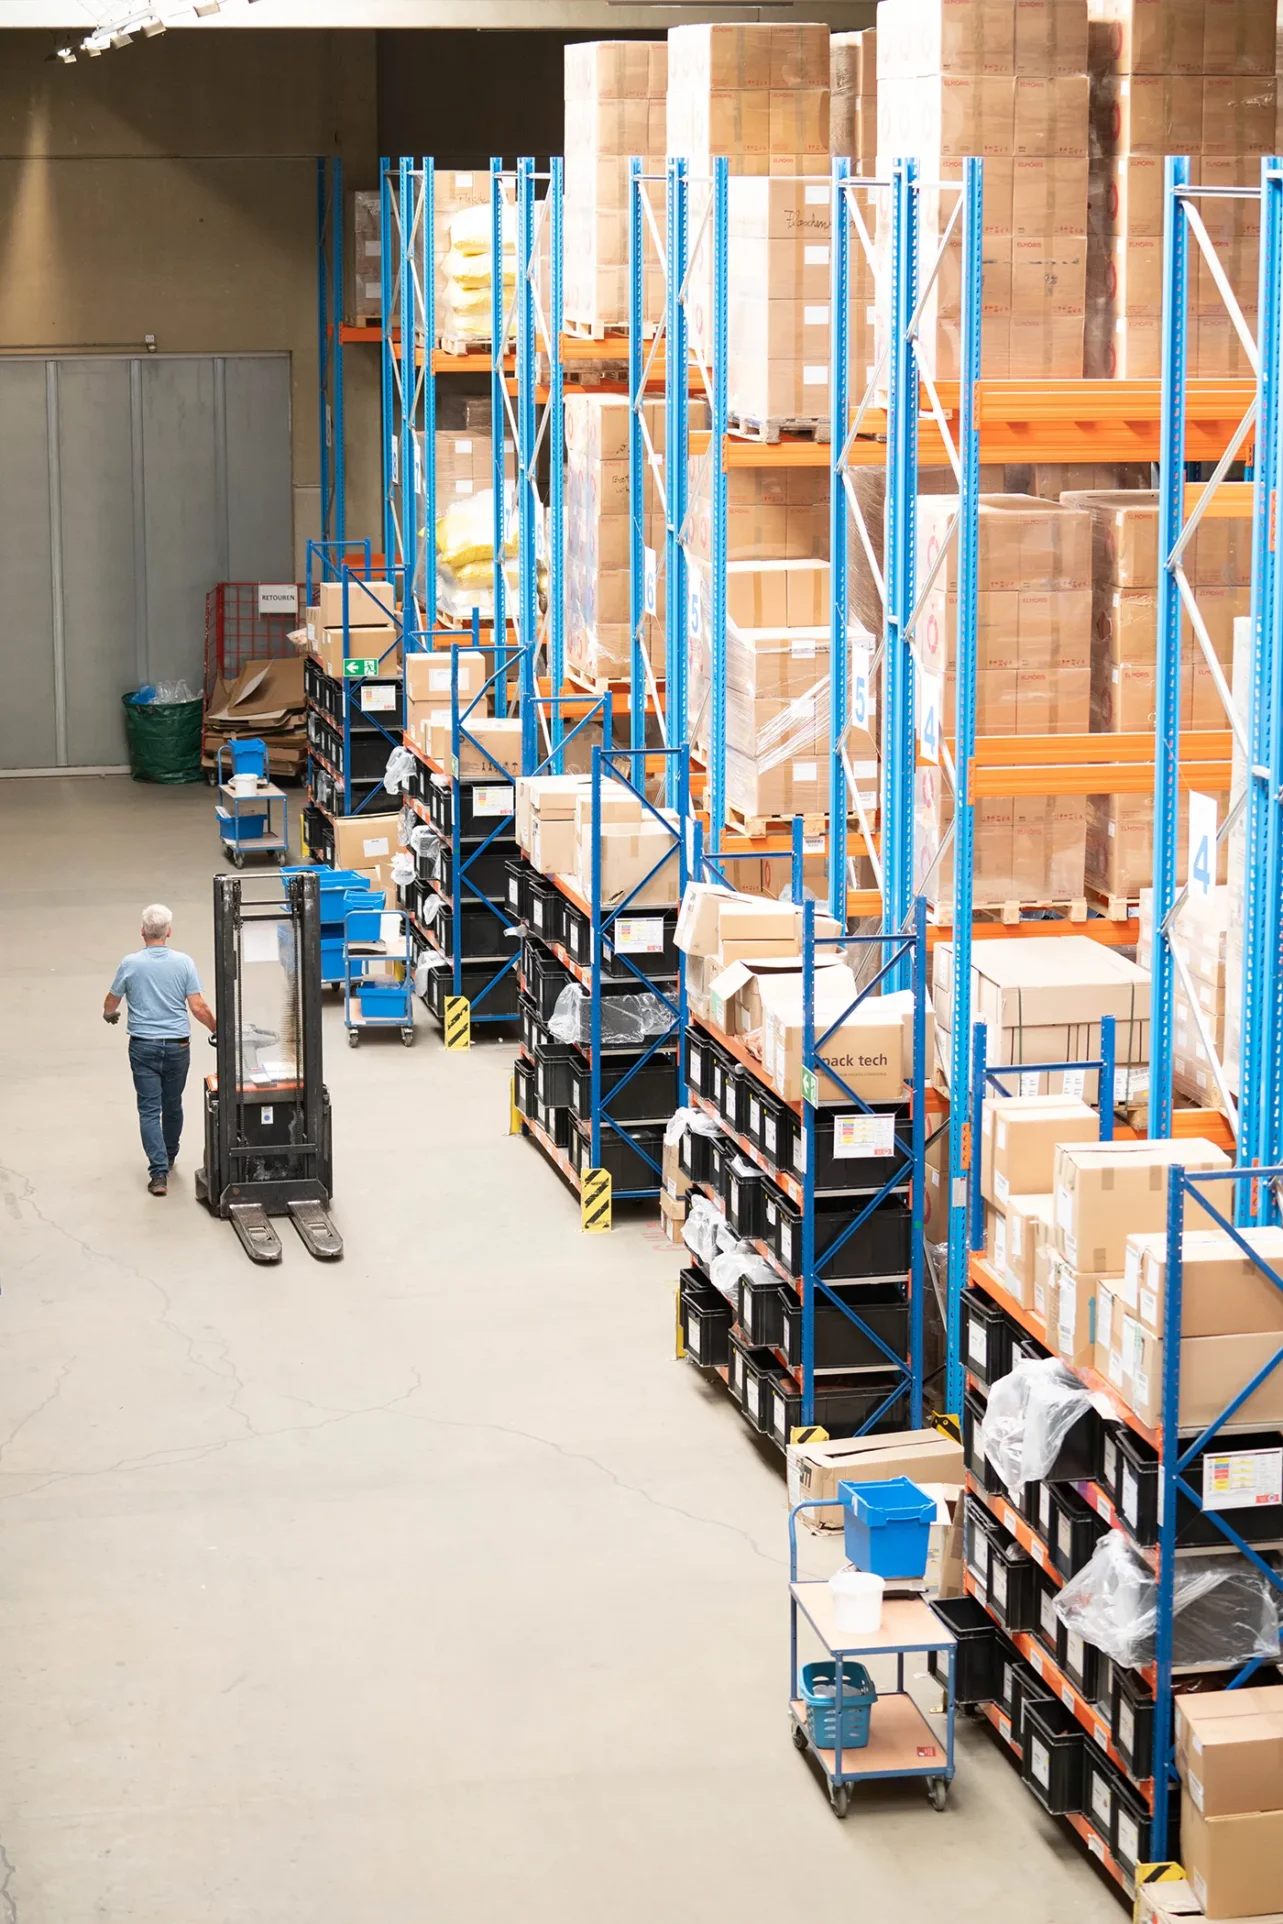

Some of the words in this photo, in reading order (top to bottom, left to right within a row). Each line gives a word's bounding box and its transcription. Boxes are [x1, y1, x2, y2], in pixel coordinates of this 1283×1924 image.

[646, 571, 655, 610] 6
[691, 593, 700, 634] 5
[855, 676, 866, 723] 5
[923, 704, 936, 755] 4
[1193, 834, 1211, 896] 4
[858, 1053, 888, 1066] tech
